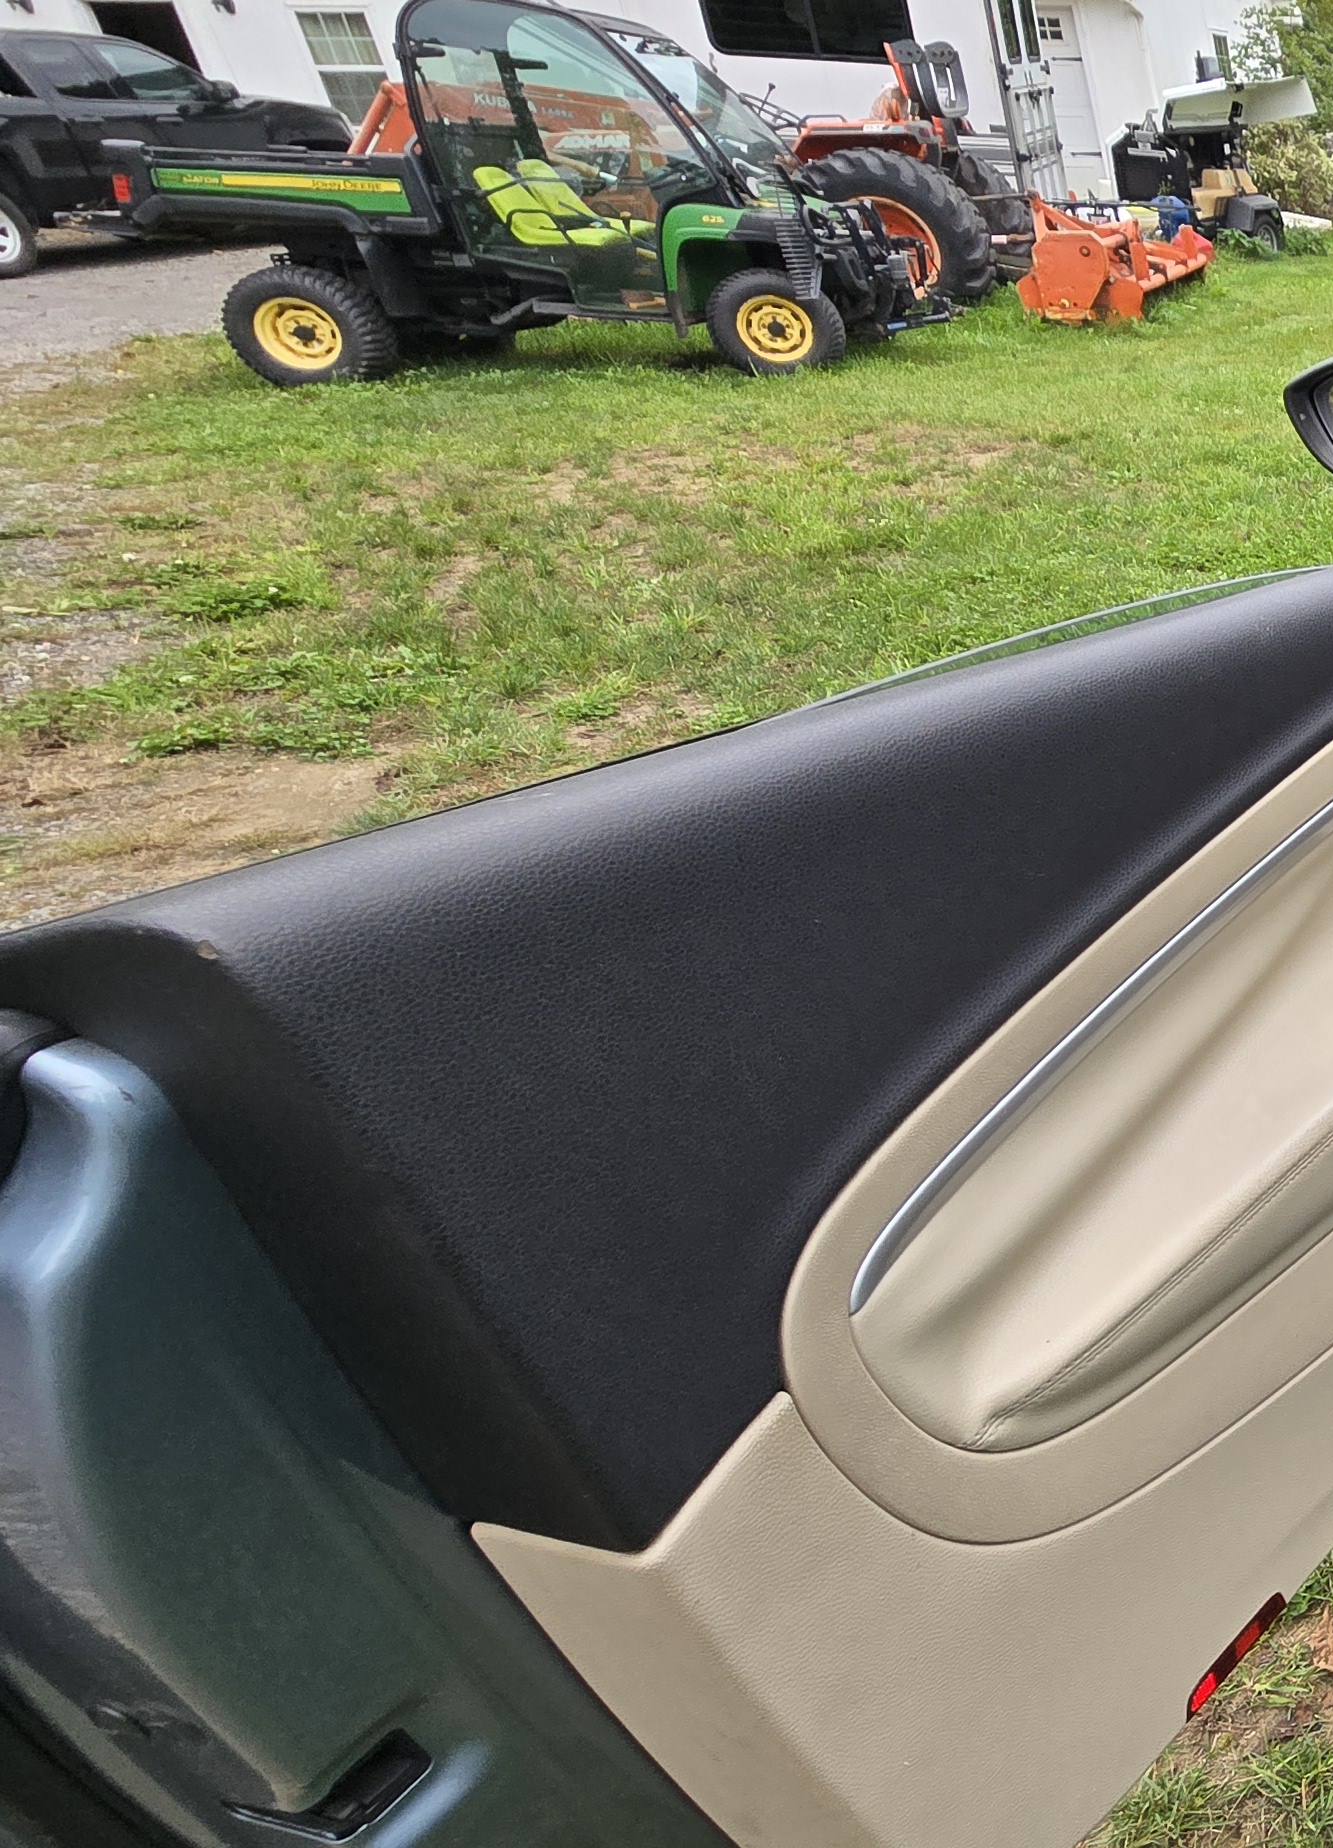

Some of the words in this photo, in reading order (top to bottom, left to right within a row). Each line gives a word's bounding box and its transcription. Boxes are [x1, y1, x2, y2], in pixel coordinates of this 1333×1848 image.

[473, 92, 538, 114] KUBA
[311, 179, 342, 191] JOHN
[342, 180, 383, 191] DEERE
